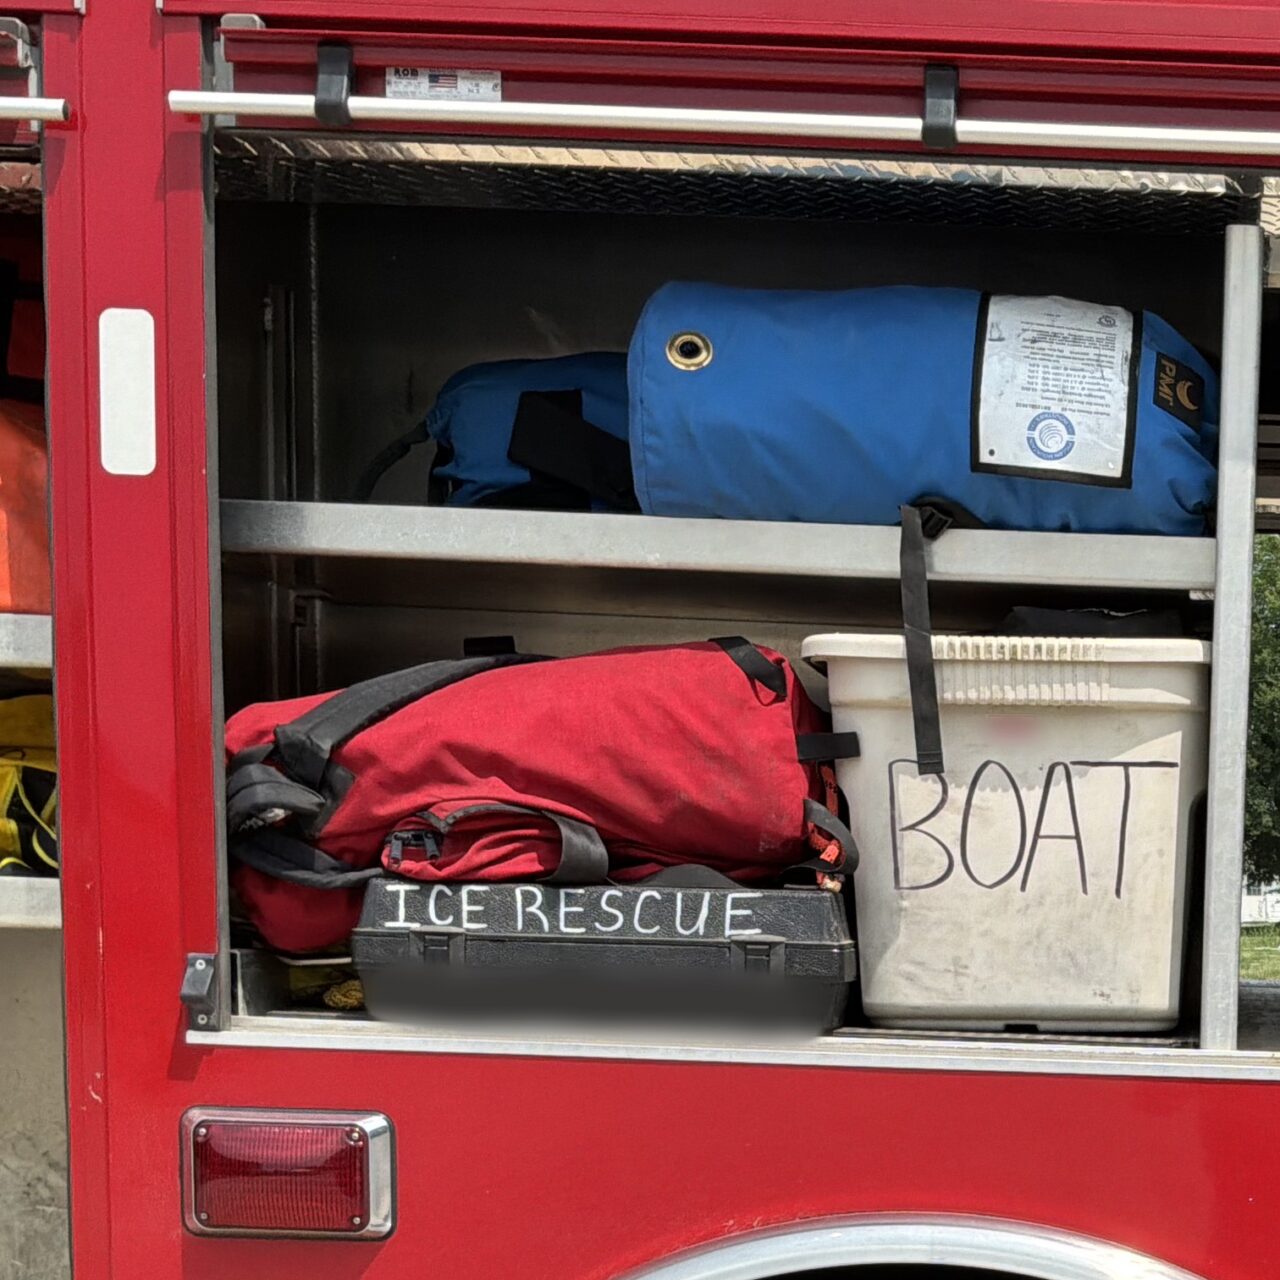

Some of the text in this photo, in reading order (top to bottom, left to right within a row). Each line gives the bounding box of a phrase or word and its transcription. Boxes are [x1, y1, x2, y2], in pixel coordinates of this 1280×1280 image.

[1158, 358, 1177, 402] PMI
[888, 758, 1179, 899] BOAT
[384, 884, 764, 938] ICE RESCUE
